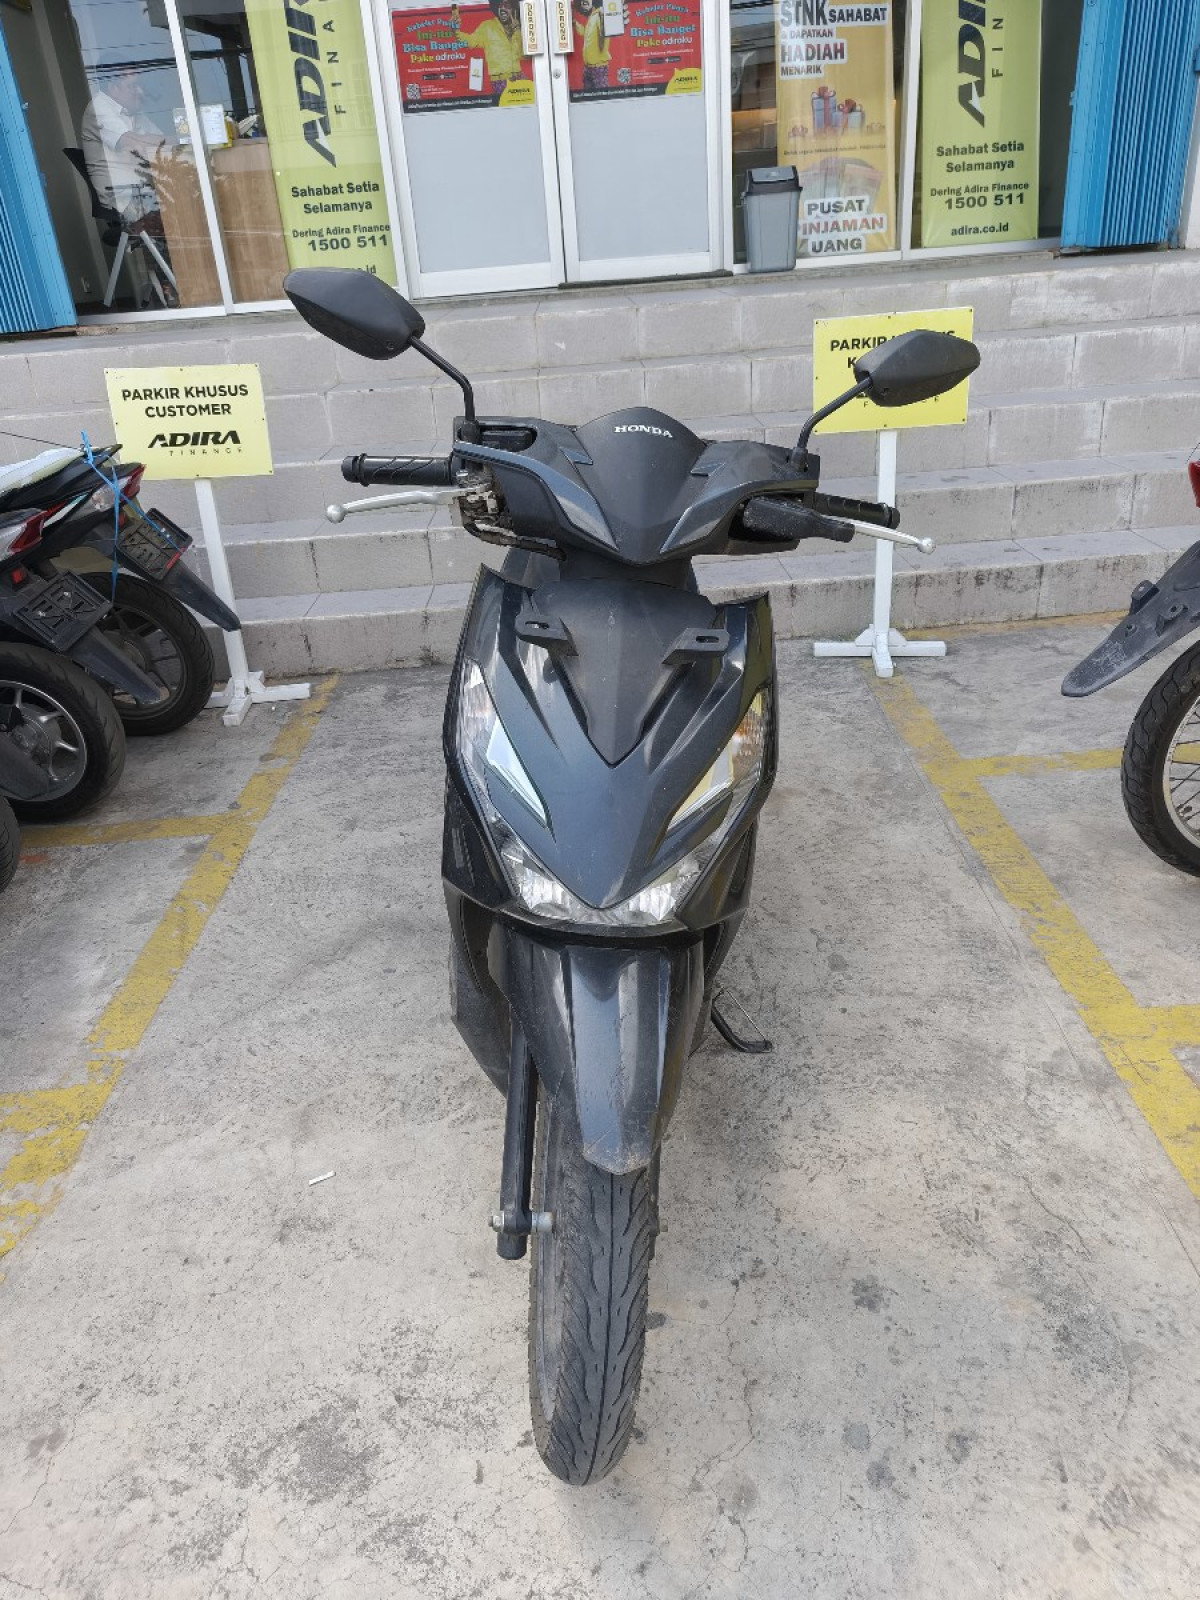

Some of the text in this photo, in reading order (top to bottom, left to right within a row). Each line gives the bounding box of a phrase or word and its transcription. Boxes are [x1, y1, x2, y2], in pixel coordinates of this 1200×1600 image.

[780, 0, 888, 27] STNK SAHABAT
[790, 28, 834, 39] DAPATKAN
[317, 0, 346, 115] FINA
[780, 42, 845, 62] HADIAH
[780, 64, 822, 76] MENARIK
[958, 0, 985, 128] ADI
[936, 140, 1025, 157] Sahabat Setia
[946, 159, 1015, 173] Selamanya
[291, 181, 380, 198] Sahabat Setia
[930, 182, 1030, 197] Dering Adira Finance
[303, 200, 373, 214] Selamanya
[807, 199, 865, 216] PUSAT
[944, 192, 1025, 210] 1500 511
[292, 224, 391, 238] Dering Adira Finance
[798, 216, 884, 236] INJAMAN
[951, 222, 1010, 236] adira.co.id
[308, 234, 388, 252] 1500 511
[811, 238, 863, 253] UANG
[121, 384, 249, 401] PARKIR KHUSUS
[144, 403, 232, 418] CUSTOMER
[147, 430, 241, 449] ADIRA
[613, 424, 673, 438] HONDA
